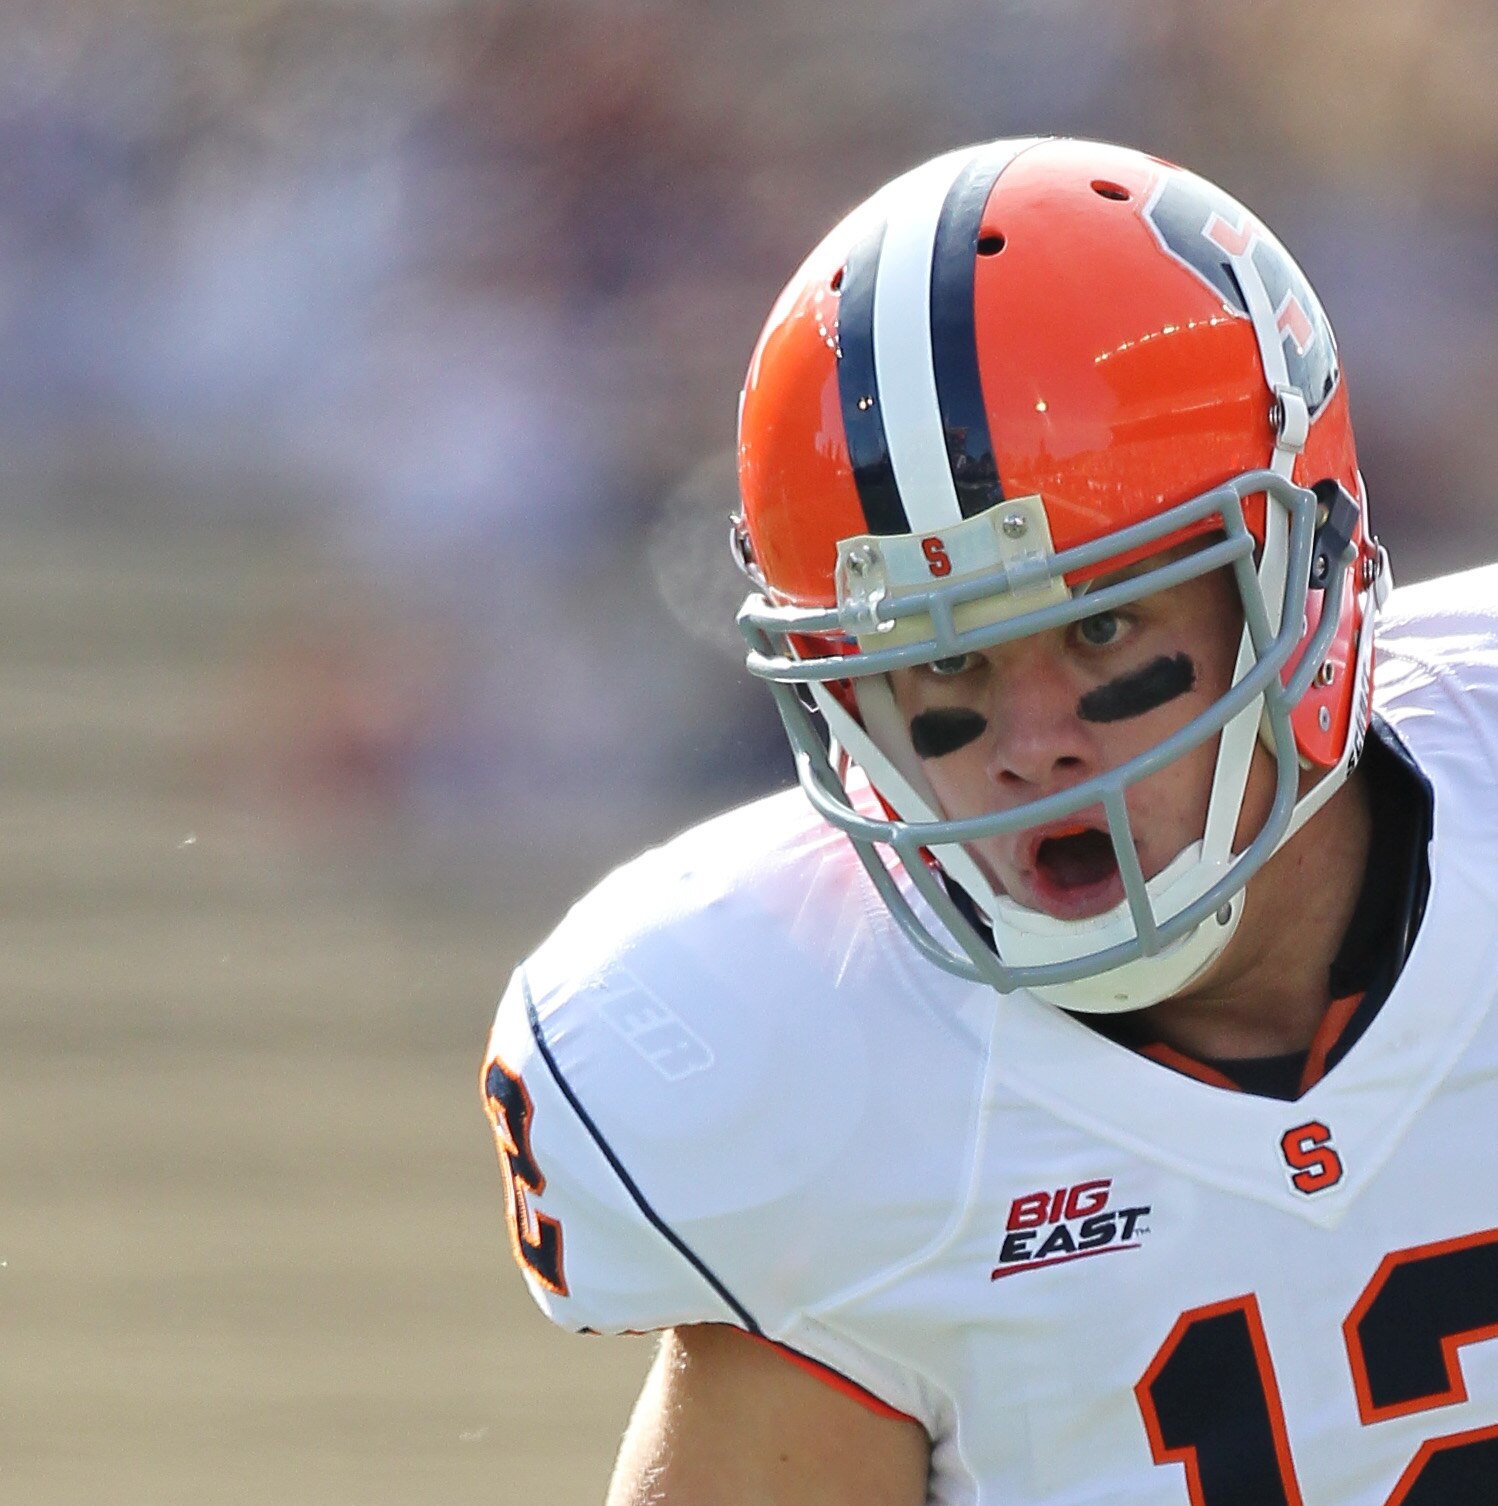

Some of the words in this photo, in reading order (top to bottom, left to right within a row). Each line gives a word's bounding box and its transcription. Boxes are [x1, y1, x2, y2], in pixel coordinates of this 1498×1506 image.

[922, 536, 952, 577] S
[1280, 1119, 1343, 1195] S
[1006, 1178, 1113, 1232] BIG
[998, 1206, 1152, 1264] EAST
